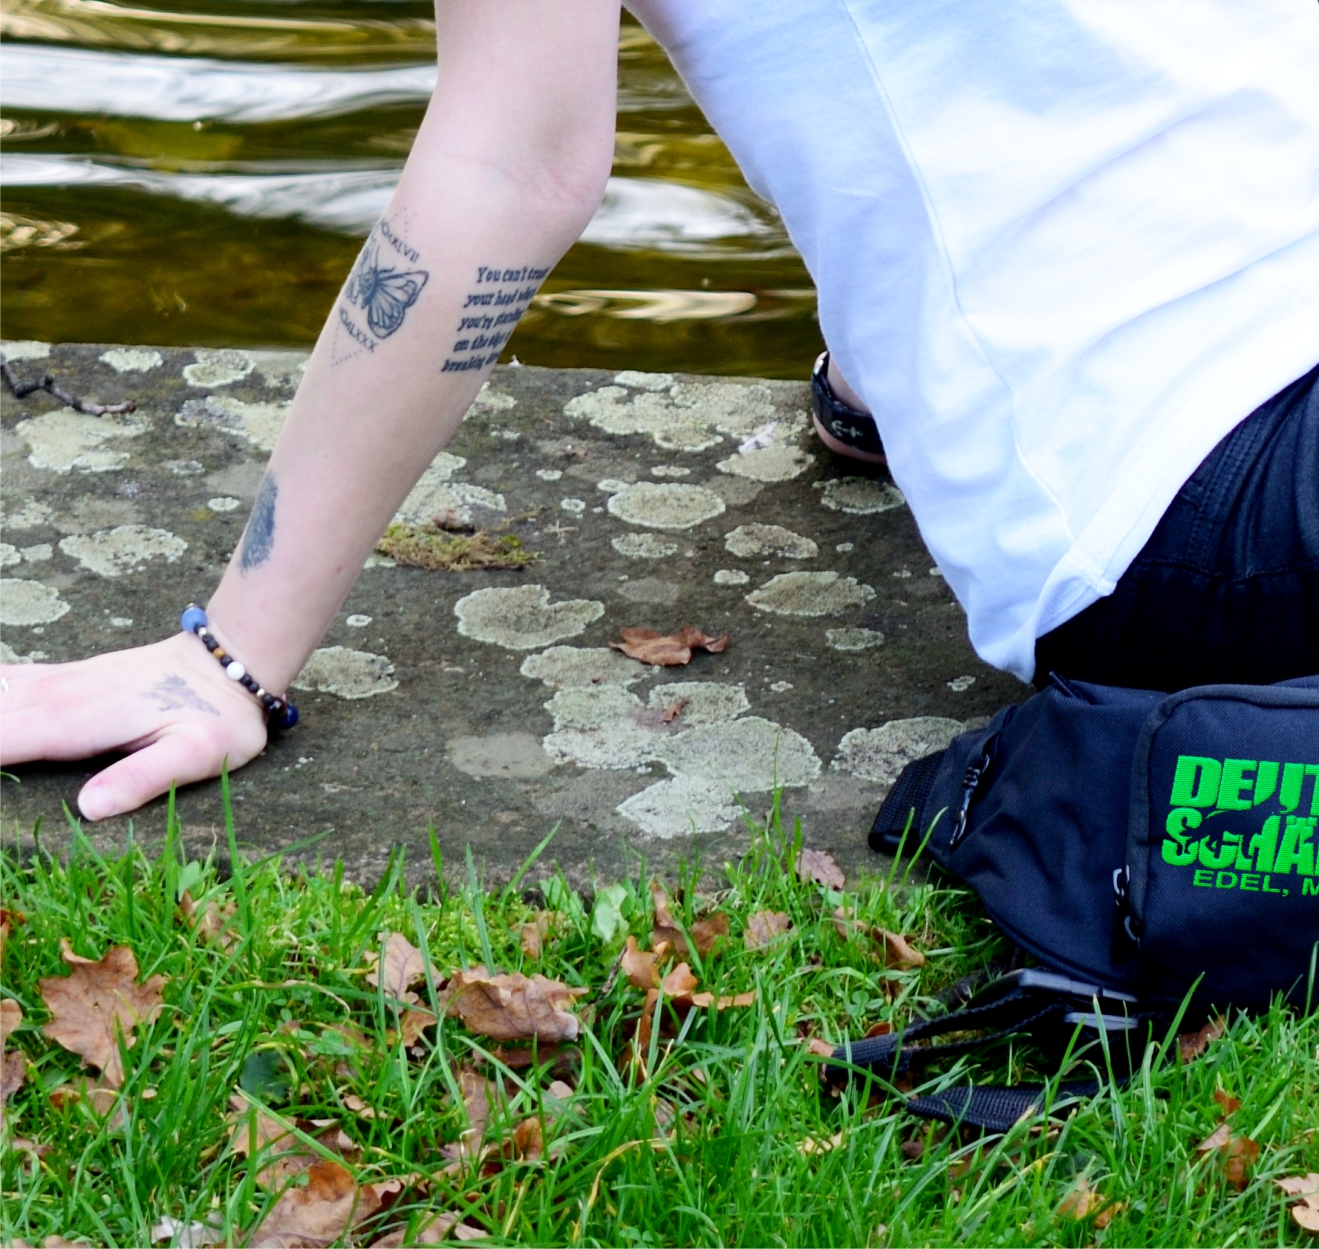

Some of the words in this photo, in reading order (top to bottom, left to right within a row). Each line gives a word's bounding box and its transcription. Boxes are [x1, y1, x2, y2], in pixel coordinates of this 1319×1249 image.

[477, 267, 501, 283] You
[503, 266, 528, 282] can't
[464, 293, 495, 307] your
[495, 289, 519, 306] head
[459, 314, 493, 331] you're
[453, 339, 470, 353] on
[1192, 869, 1289, 897] EDEL,
